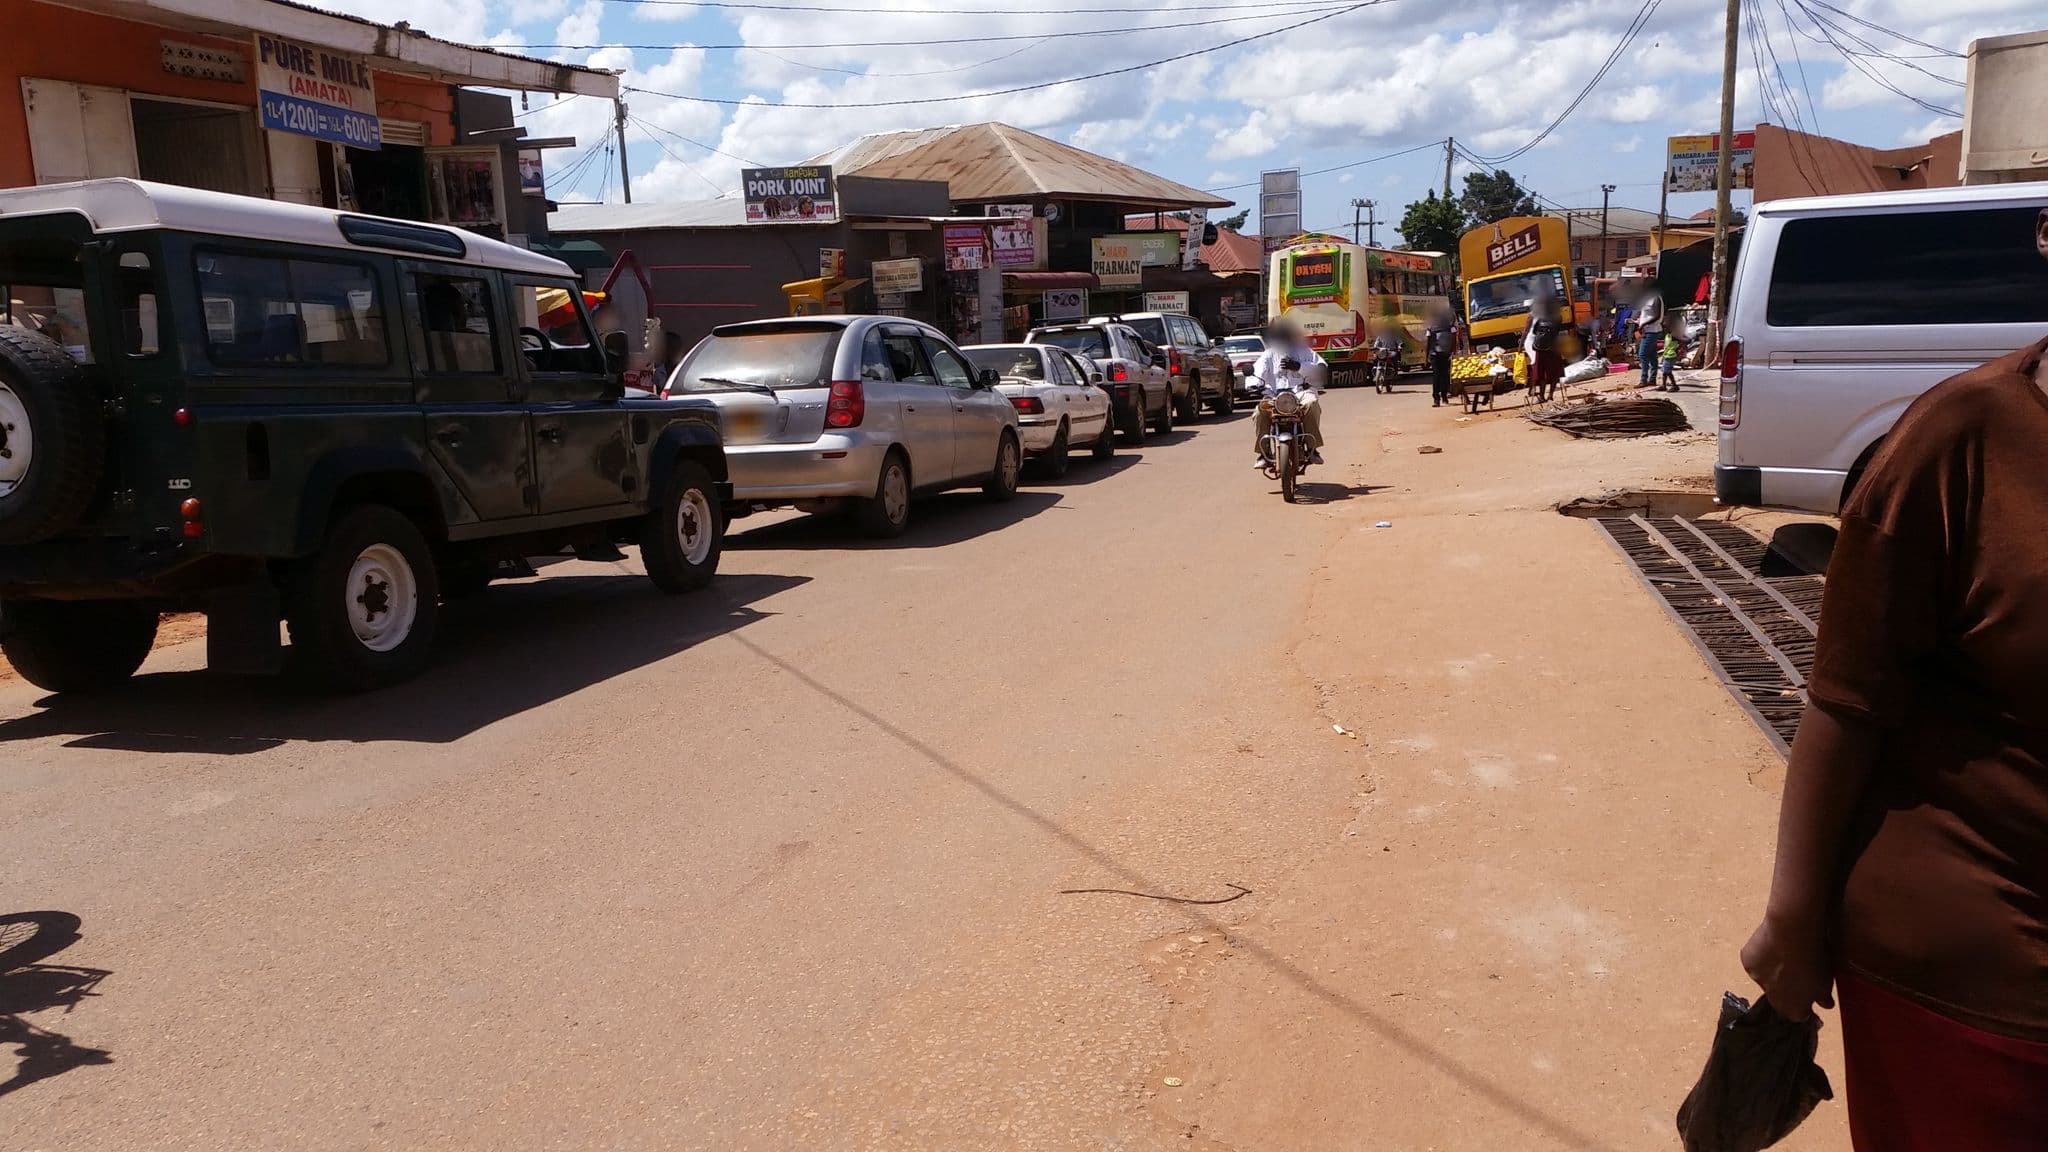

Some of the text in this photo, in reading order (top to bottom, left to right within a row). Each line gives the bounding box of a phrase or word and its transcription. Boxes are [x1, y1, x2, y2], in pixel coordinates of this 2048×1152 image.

[259, 35, 370, 90] PURE MILK
[288, 75, 353, 107] (AMATA)
[748, 177, 826, 197] PORK JOINT
[1143, 239, 1164, 248] ENDERS
[1491, 232, 1537, 262] BELL
[1093, 260, 1140, 275] PHARMACY
[1295, 263, 1332, 276] OXYGEN
[1149, 302, 1184, 310] PHARMACY
[167, 478, 192, 489] 110
